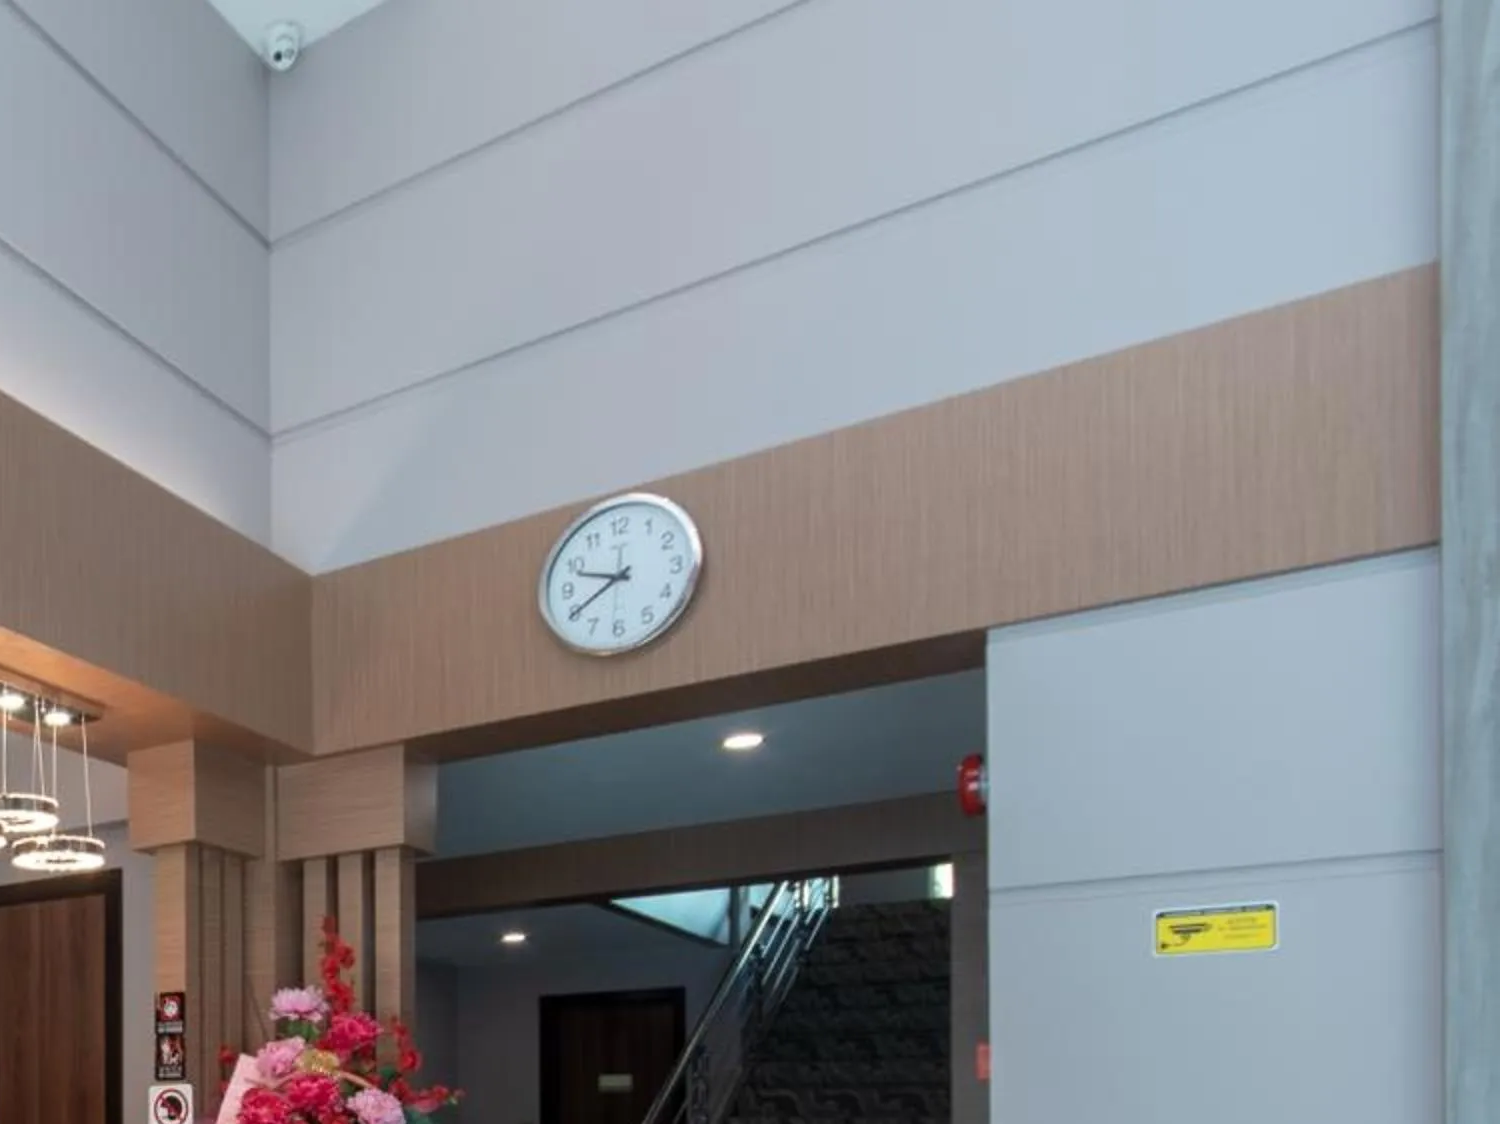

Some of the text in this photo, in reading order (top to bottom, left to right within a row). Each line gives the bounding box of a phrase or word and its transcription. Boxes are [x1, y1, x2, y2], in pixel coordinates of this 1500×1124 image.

[611, 516, 630, 536] 12
[644, 519, 653, 534] 1
[586, 532, 601, 549] 11
[660, 530, 675, 550] 2
[567, 556, 585, 574] 10
[669, 555, 683, 574] 3
[561, 582, 574, 600] 9
[659, 582, 671, 599] 4
[641, 605, 655, 624] 5
[587, 617, 599, 636] 7
[612, 618, 625, 637] 6
